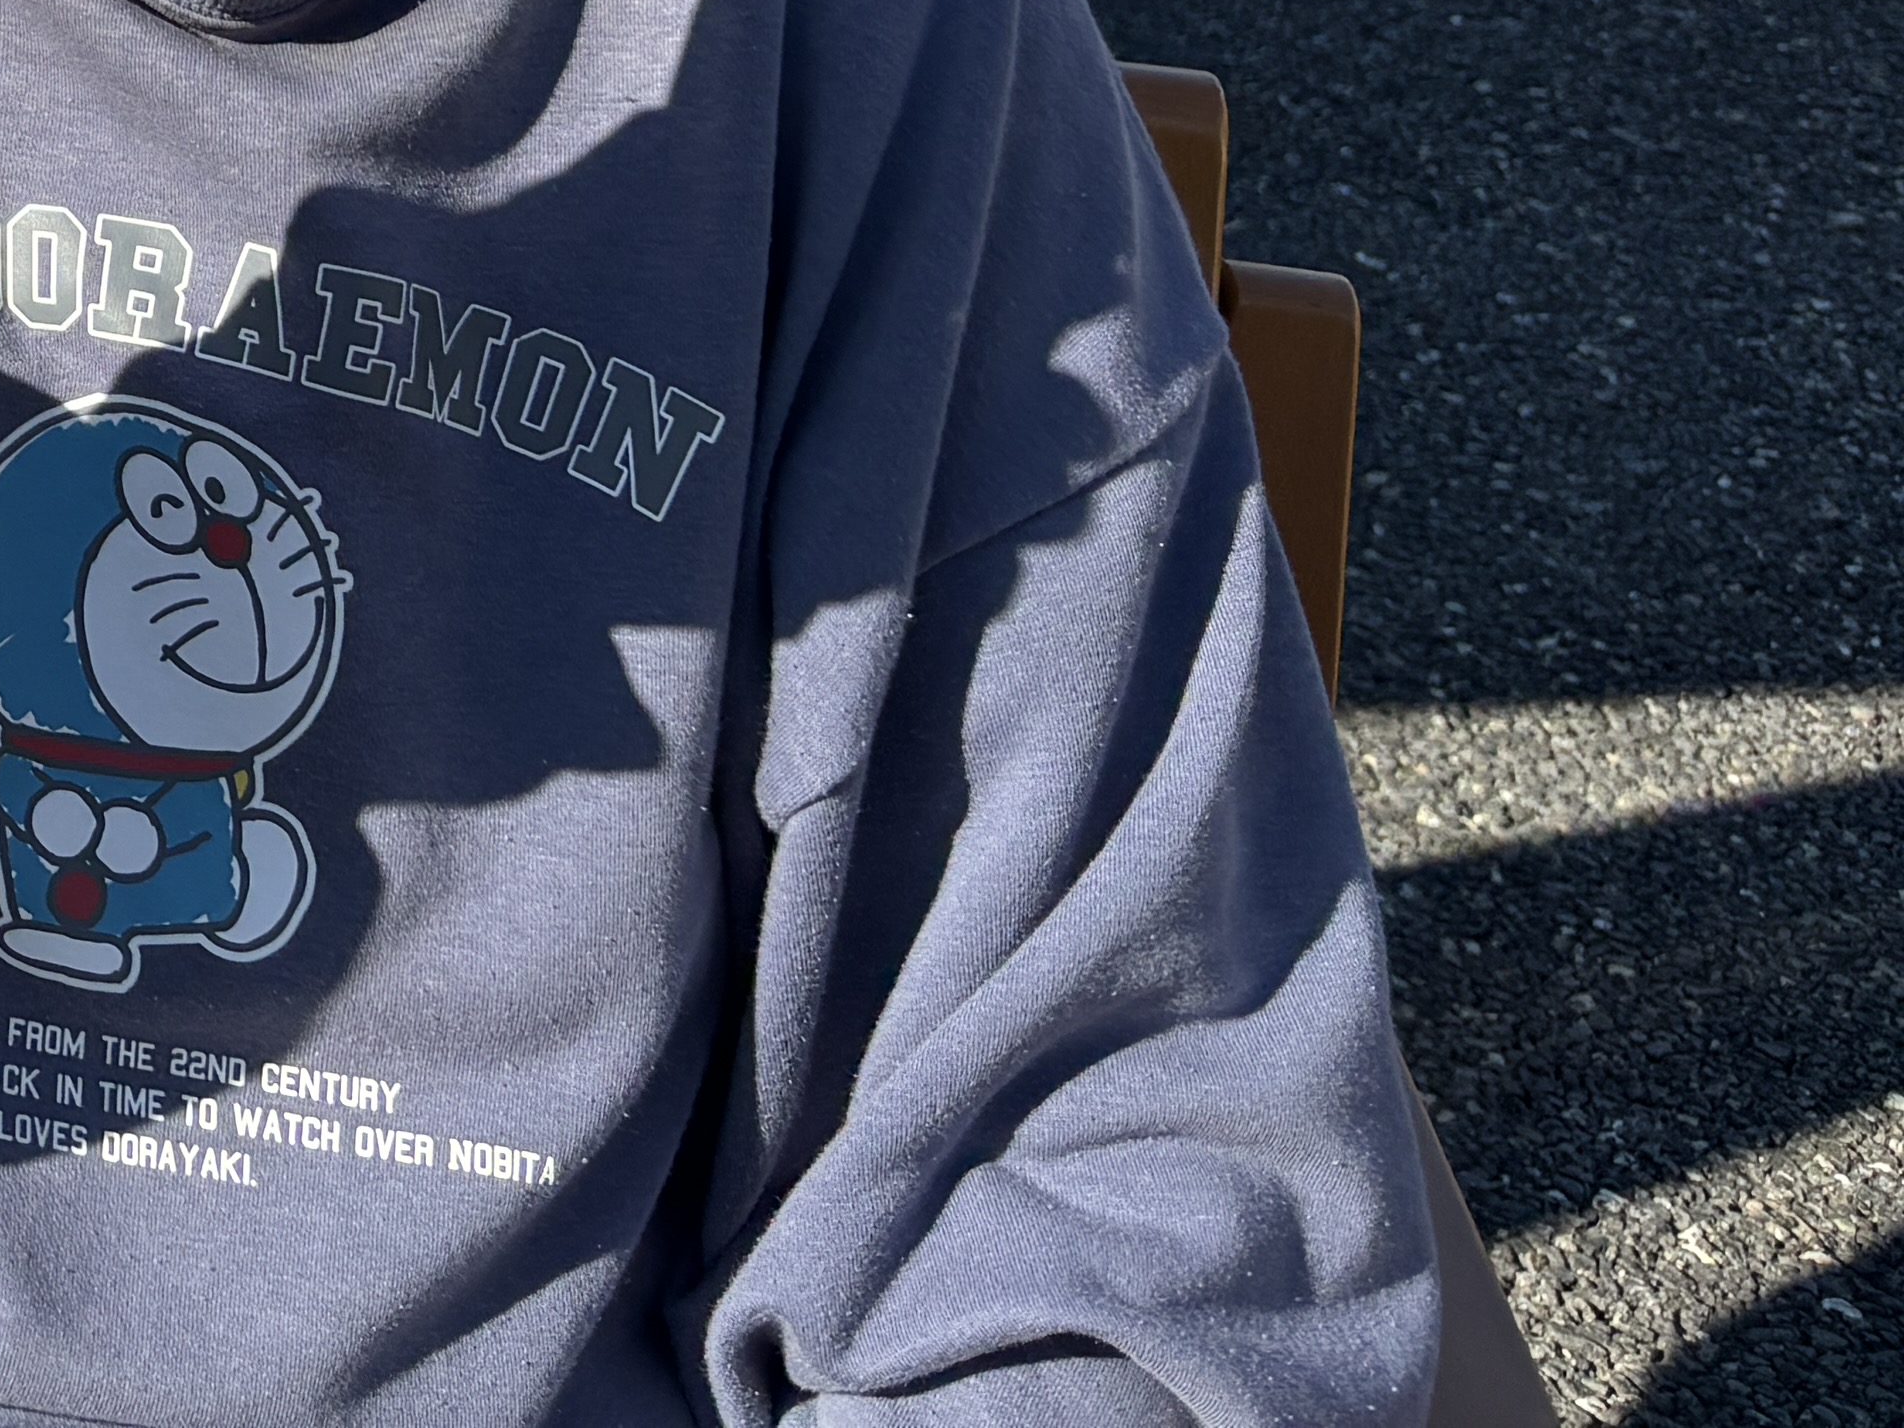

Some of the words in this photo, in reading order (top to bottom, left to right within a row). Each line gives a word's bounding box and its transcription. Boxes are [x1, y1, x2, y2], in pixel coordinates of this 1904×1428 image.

[7, 1017, 87, 1059] FROM
[101, 1035, 155, 1072] THE
[169, 1047, 247, 1087] 22ND
[261, 1061, 401, 1114] CENTURY
[55, 1072, 83, 1108] IN
[98, 1080, 166, 1122] TIME
[181, 1093, 218, 1131] TO
[232, 1101, 341, 1153] WATCH
[354, 1125, 434, 1167] OVER
[447, 1137, 556, 1186] NOBITA
[101, 1130, 258, 1187] DORAYAKI.
